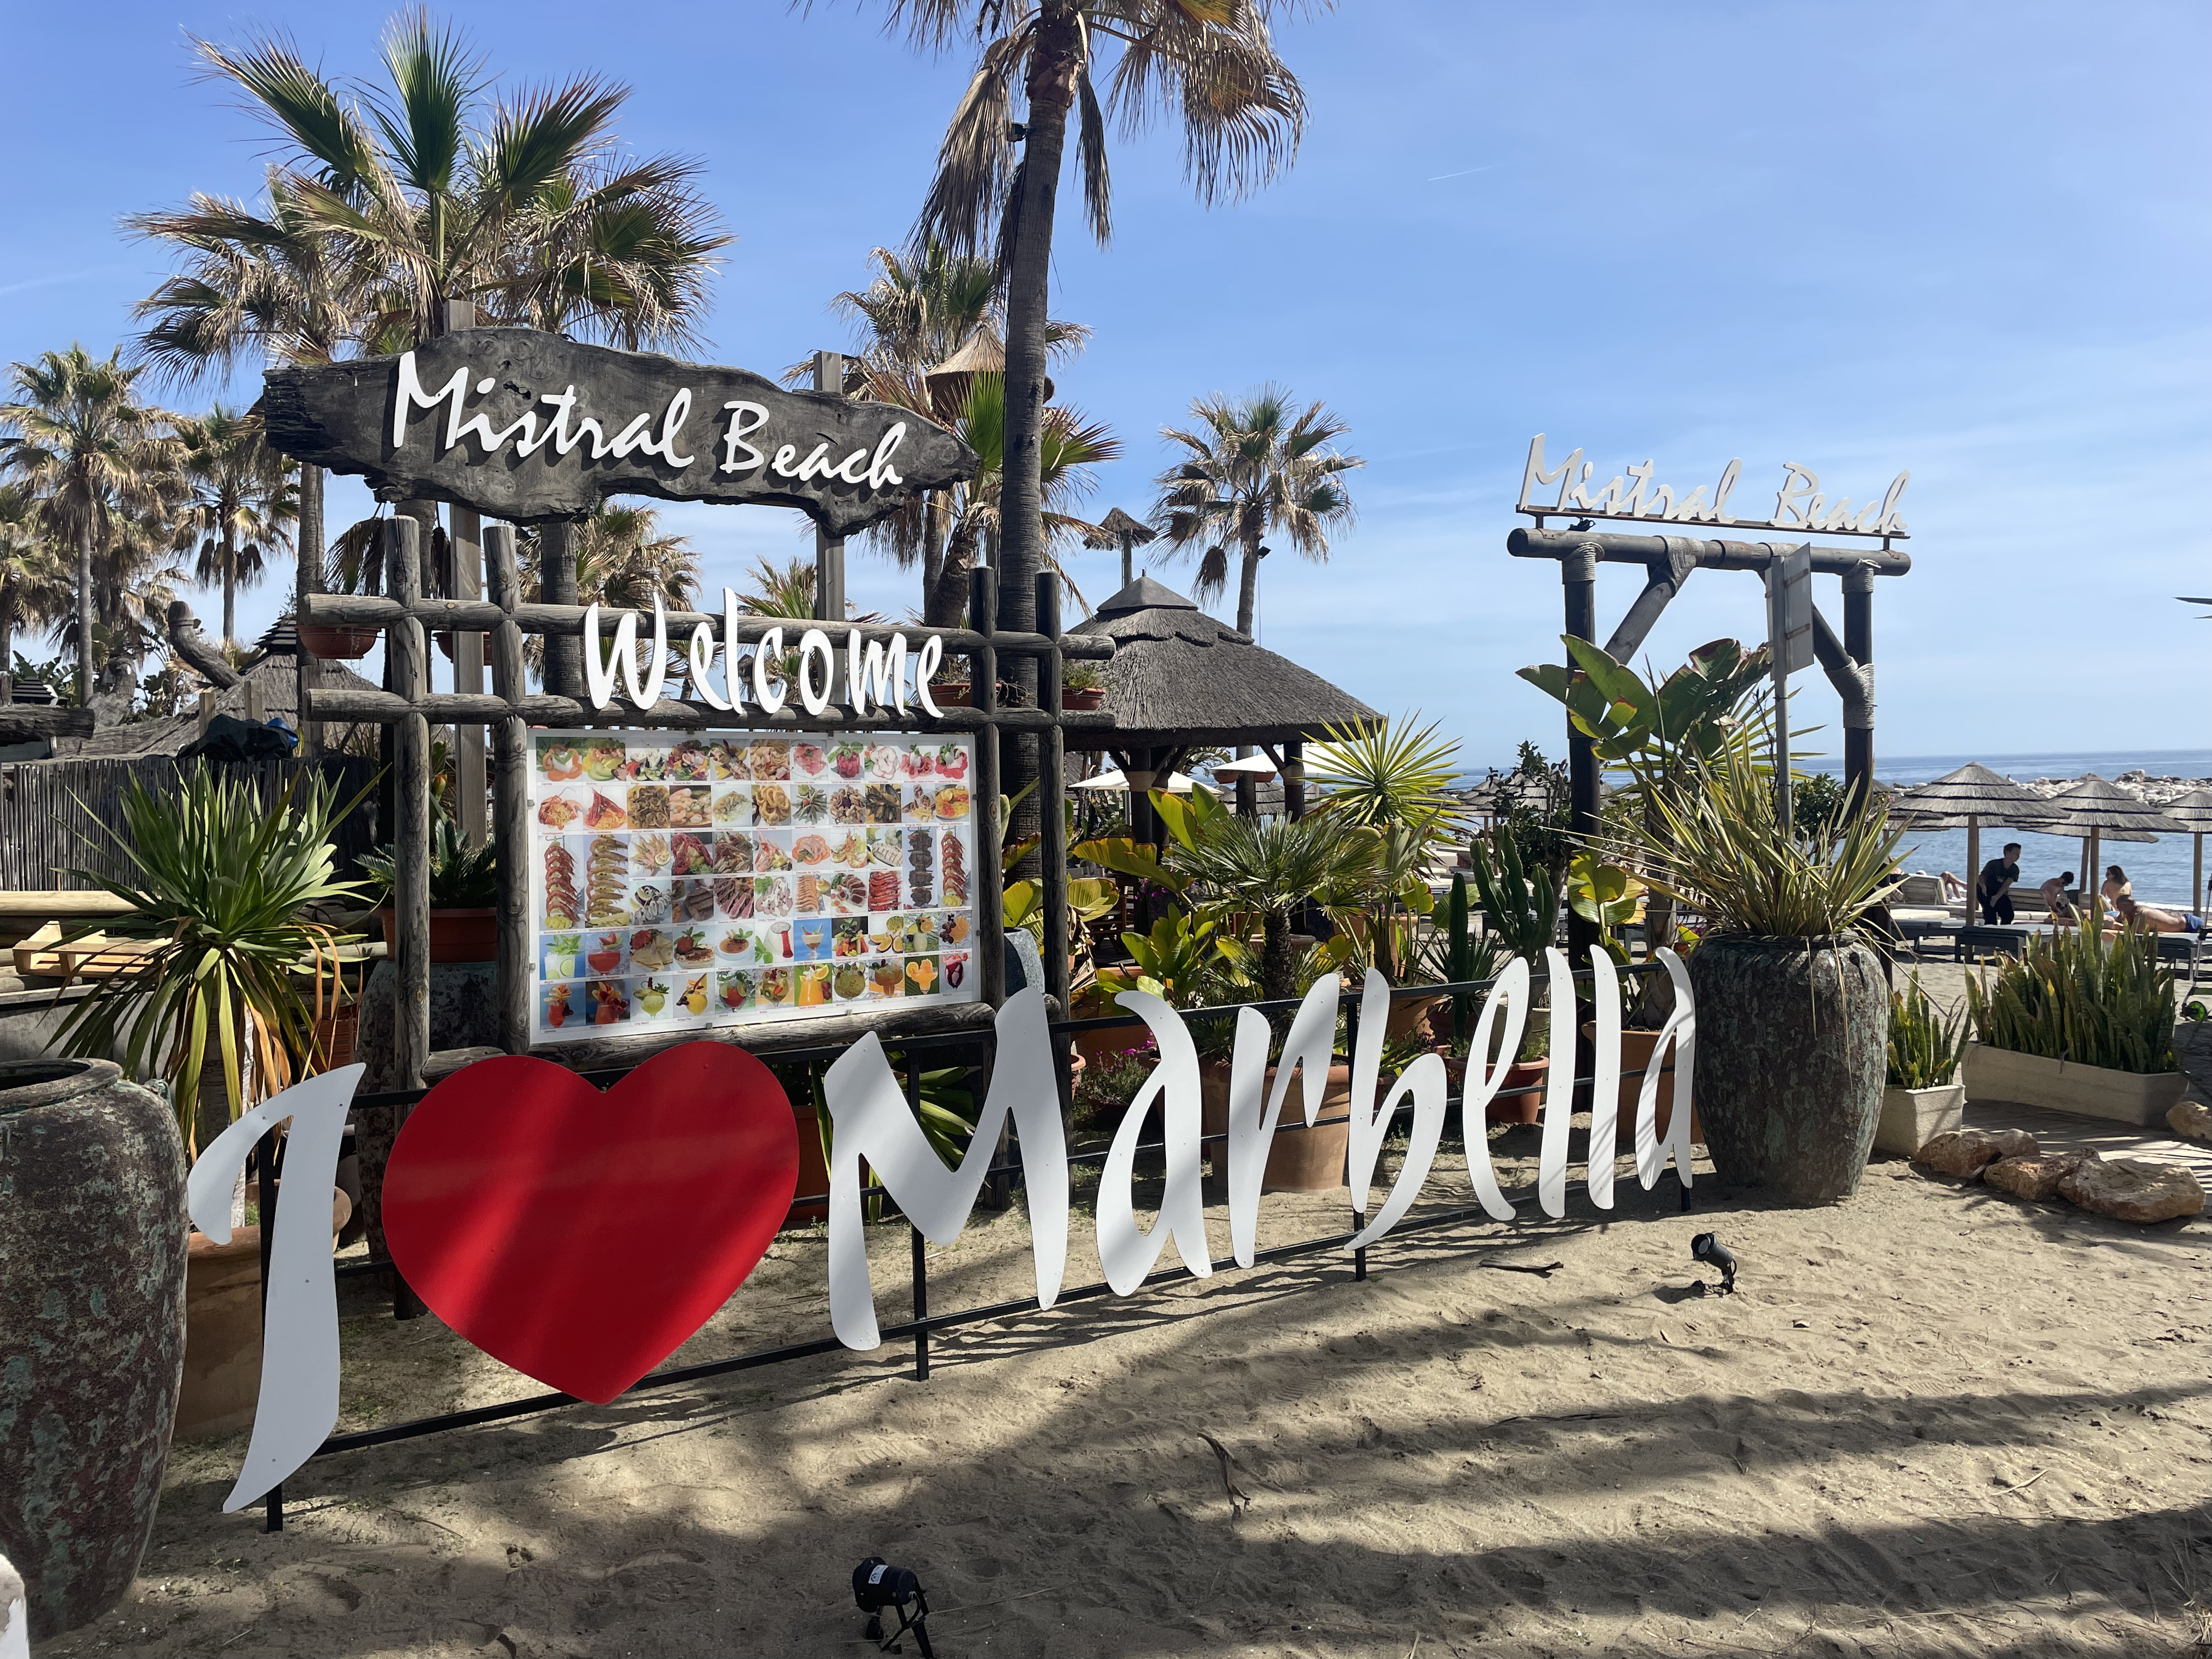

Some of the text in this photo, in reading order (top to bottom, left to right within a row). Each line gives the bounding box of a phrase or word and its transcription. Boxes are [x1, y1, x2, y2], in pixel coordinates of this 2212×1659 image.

[394, 351, 902, 489] Mistral Beach
[1519, 433, 1910, 534] Mistral Beach
[584, 587, 944, 718] Welcome
[188, 946, 1696, 1514] I Marbella
